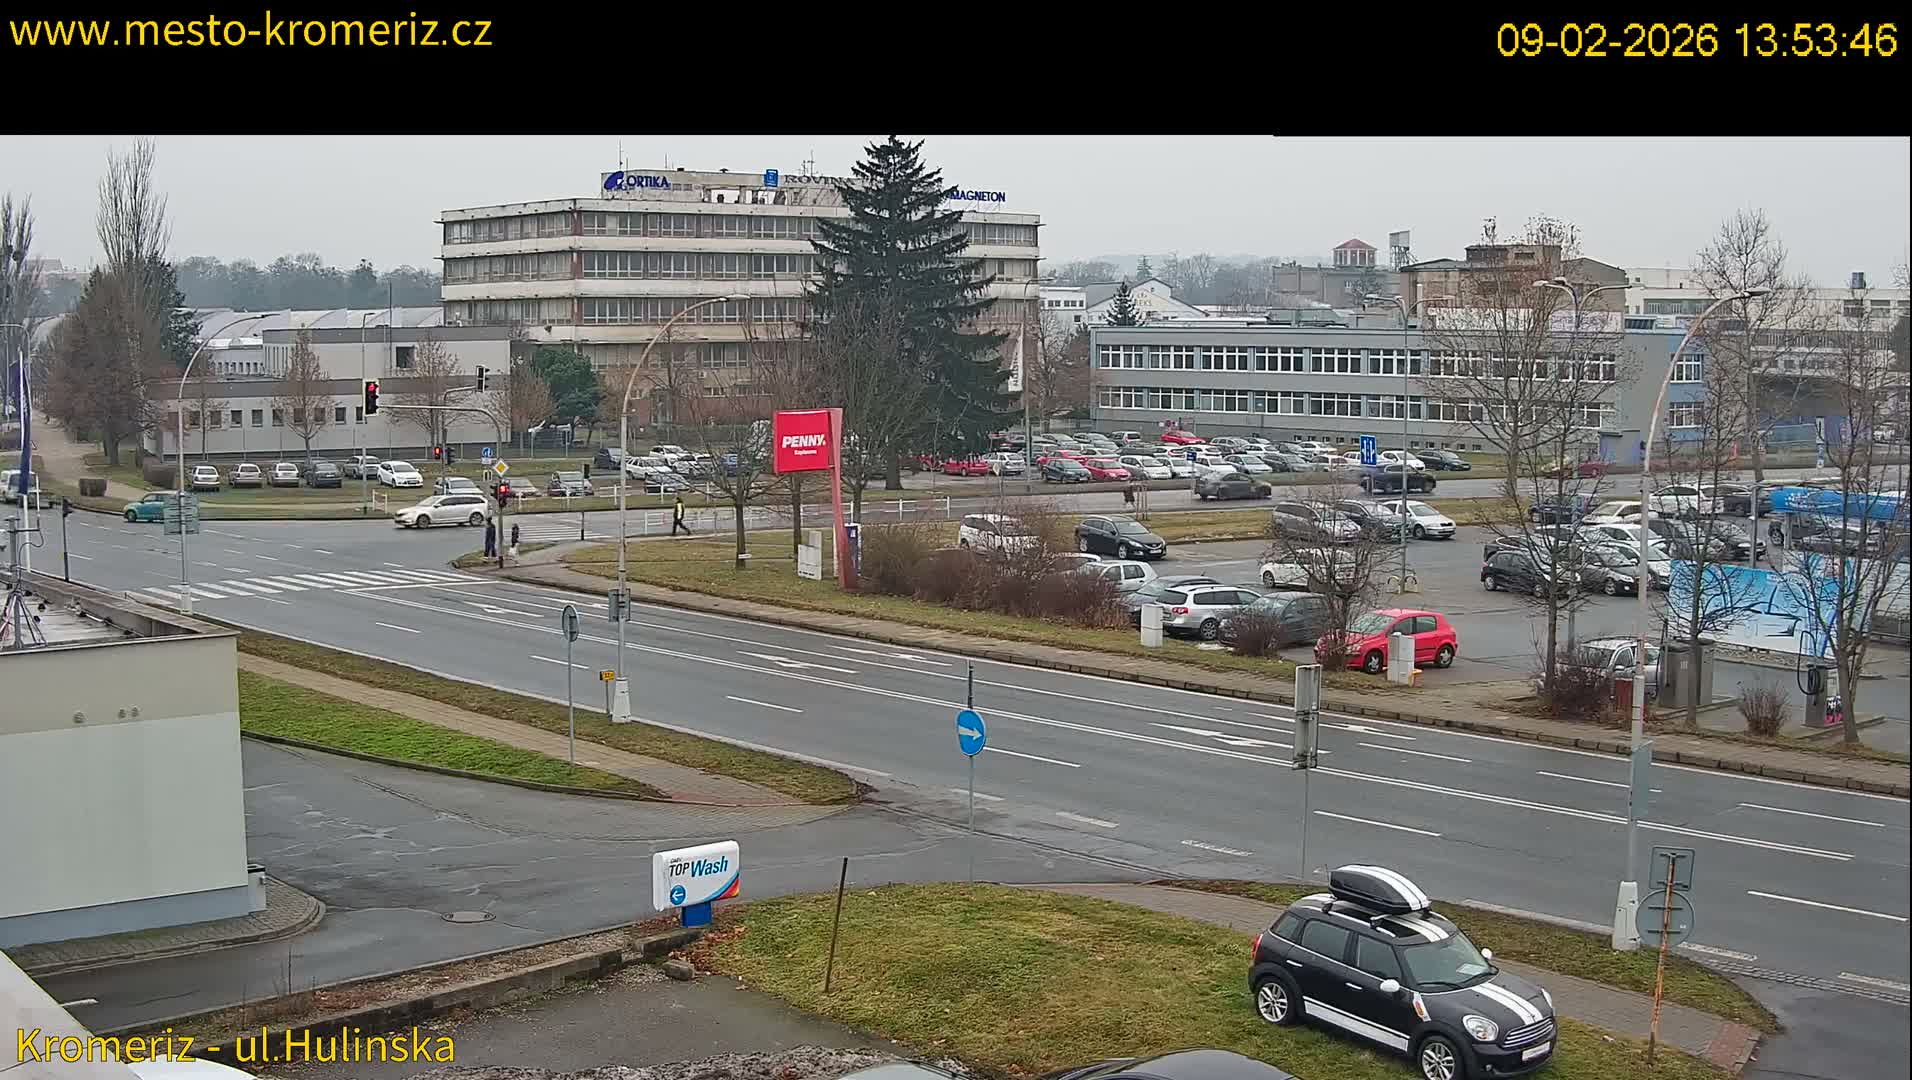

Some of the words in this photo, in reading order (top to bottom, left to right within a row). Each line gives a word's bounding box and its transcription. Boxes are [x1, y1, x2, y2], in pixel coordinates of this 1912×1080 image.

[626, 175, 669, 188] ORTIKA
[950, 190, 1006, 202] MAGNETON
[669, 862, 690, 877] TOP
[691, 855, 728, 878] Wash
